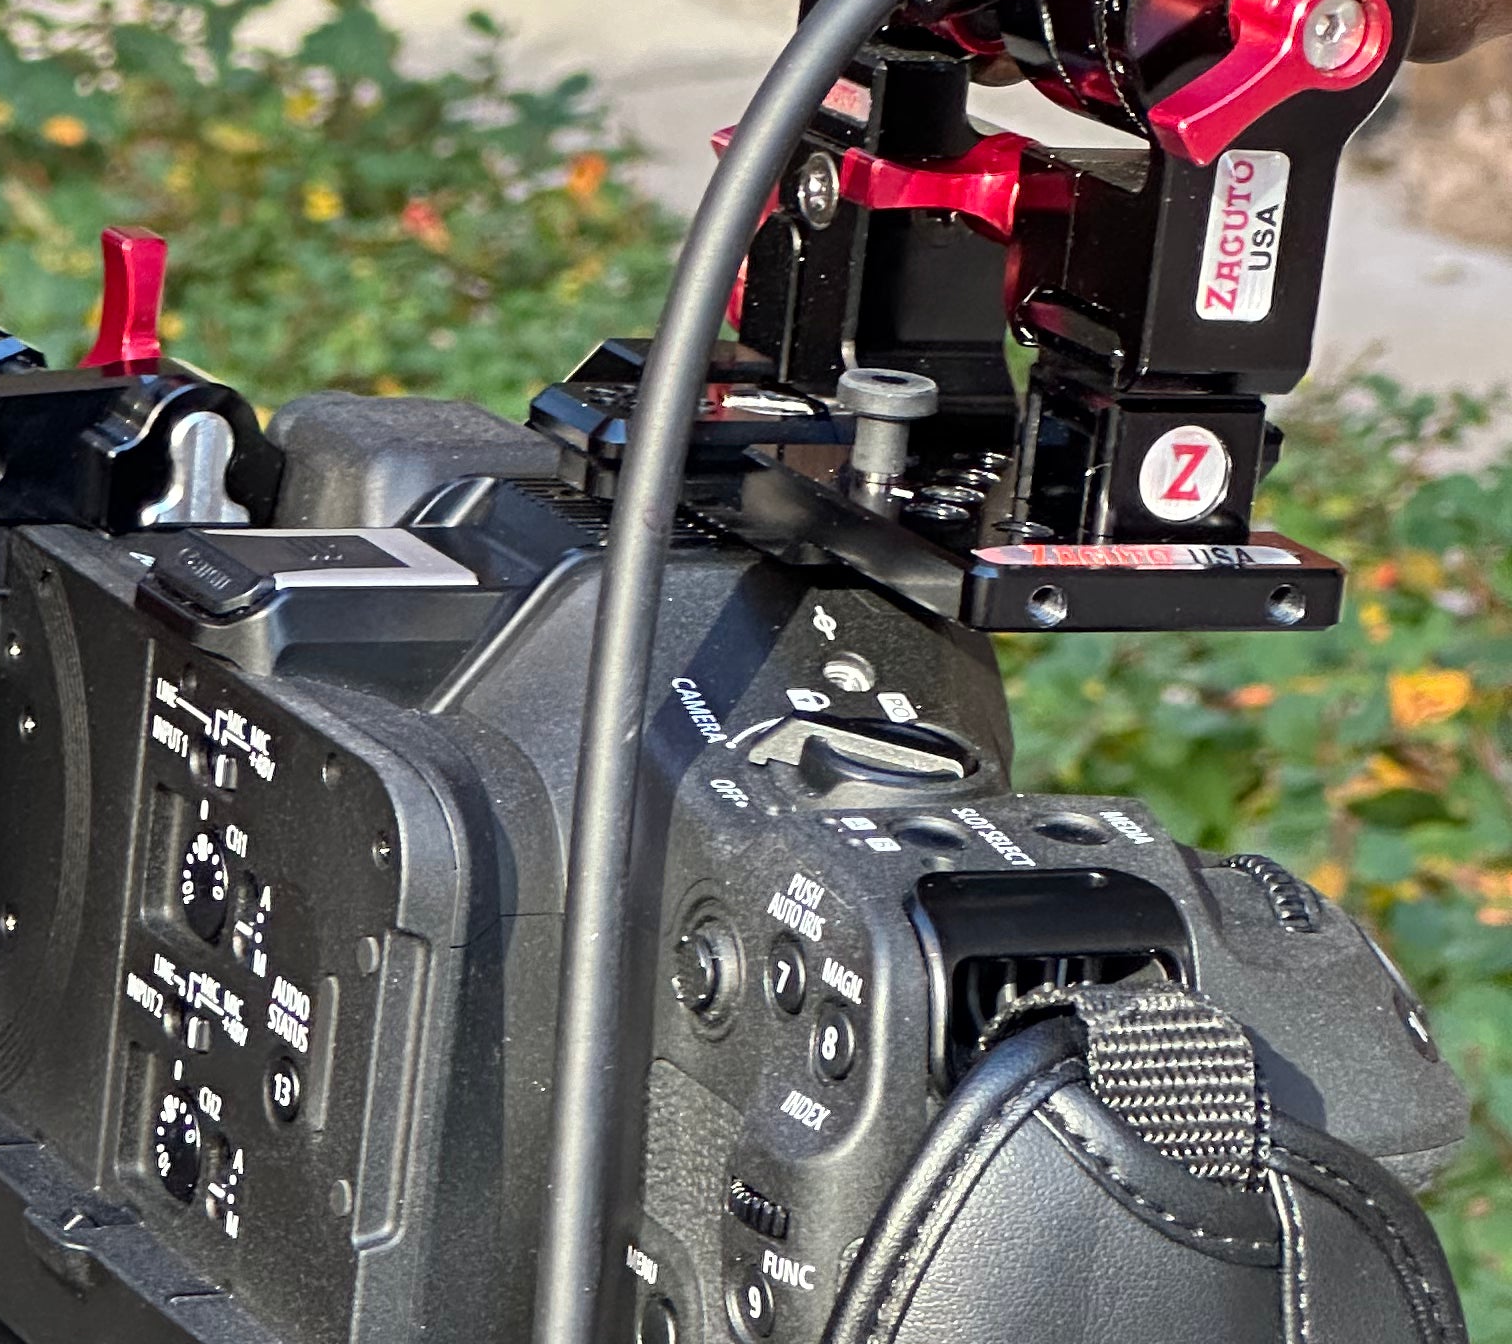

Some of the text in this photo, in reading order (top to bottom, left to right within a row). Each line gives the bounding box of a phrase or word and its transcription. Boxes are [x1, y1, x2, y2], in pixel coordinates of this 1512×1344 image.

[1203, 159, 1255, 315] ZACUTO
[1247, 203, 1280, 271] USA
[1160, 442, 1210, 501] Z
[1187, 546, 1256, 569] USA
[671, 677, 728, 745] CAMERA
[710, 778, 748, 805] OFF
[1099, 810, 1156, 845] MEDIA
[978, 830, 1037, 868] SELECT
[787, 872, 826, 911] PUSH
[767, 891, 826, 942] AUTO IRIS
[776, 960, 792, 994] 7
[821, 957, 864, 1004] MAGN.
[271, 975, 311, 1022] AUDIO
[267, 1003, 310, 1053] STATUS
[821, 1025, 839, 1061] 8
[274, 1072, 292, 1107] 13
[780, 1089, 832, 1131] INDEX
[762, 1248, 817, 1290] FUNC
[747, 1285, 763, 1320] 9
